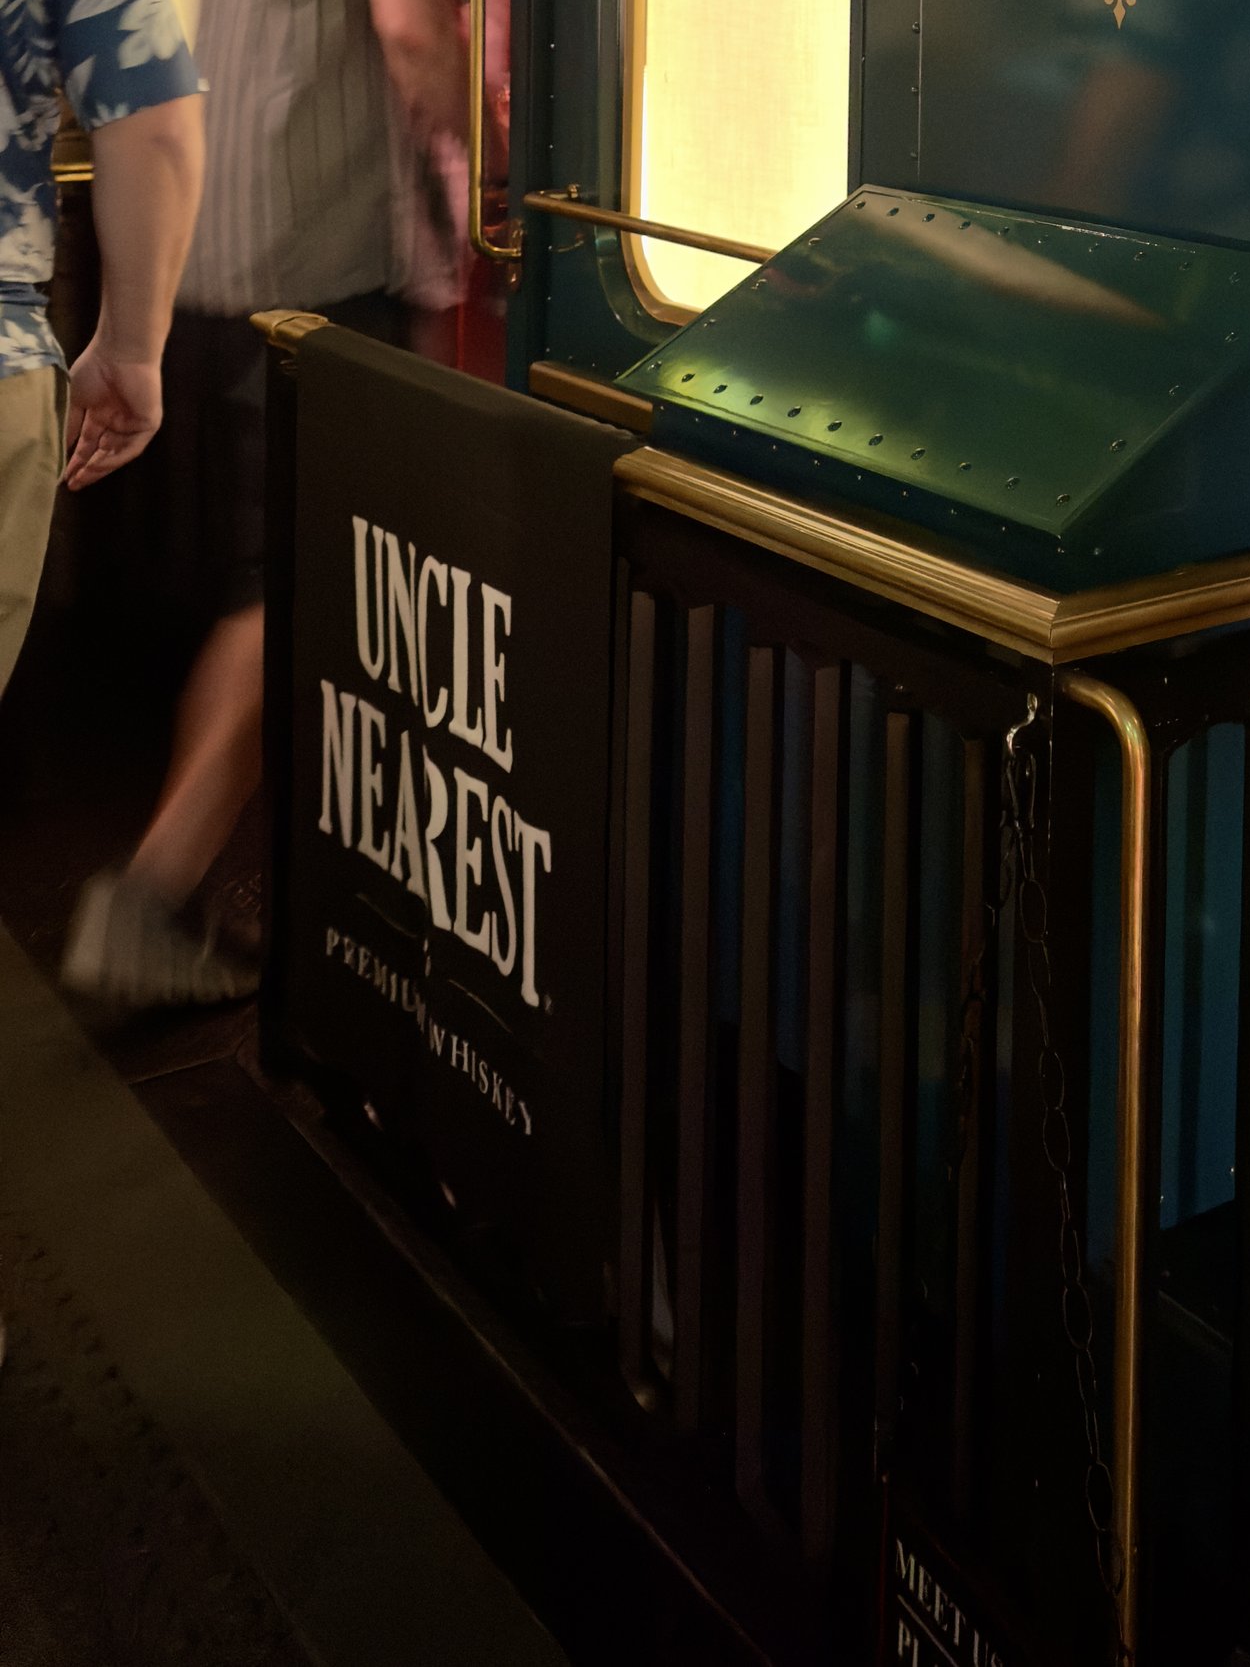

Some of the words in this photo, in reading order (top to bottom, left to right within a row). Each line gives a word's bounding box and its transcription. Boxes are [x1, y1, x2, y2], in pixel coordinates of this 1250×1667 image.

[352, 515, 512, 774] UNCLE
[318, 679, 552, 1007] NEAREST
[325, 925, 427, 1034] PREMIUM
[429, 1016, 533, 1136] WHISKEY
[896, 1537, 967, 1647] MEET
